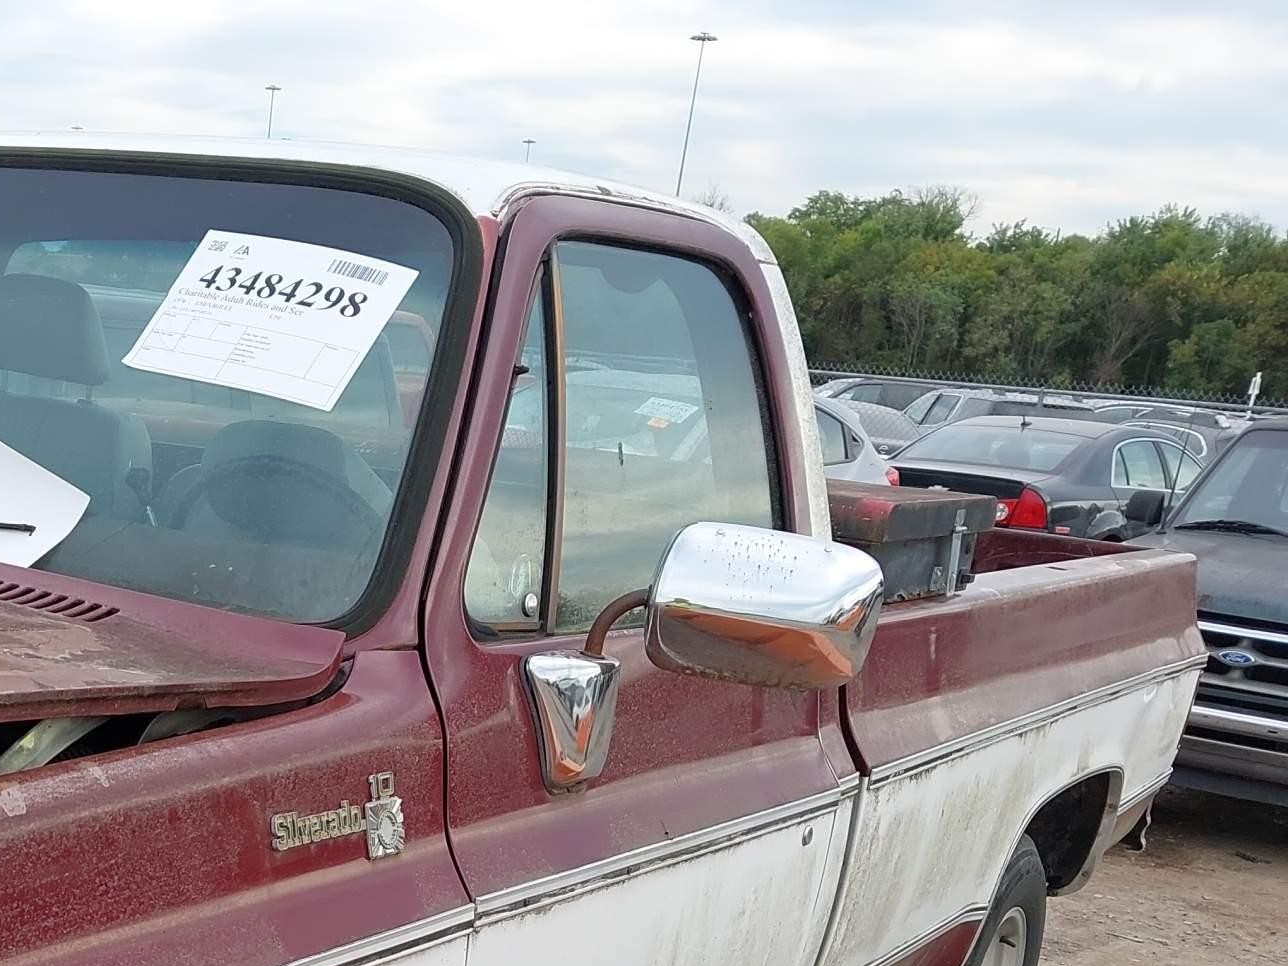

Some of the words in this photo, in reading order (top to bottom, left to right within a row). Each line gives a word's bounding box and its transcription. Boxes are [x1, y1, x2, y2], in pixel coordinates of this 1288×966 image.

[178, 287, 220, 302] Charitable
[221, 295, 245, 305] Adult
[245, 299, 270, 310] Rides
[270, 304, 288, 313] and
[199, 264, 369, 318] 43484298
[1225, 653, 1249, 664] Ford
[367, 771, 394, 801] 10
[271, 799, 362, 851] Silverado
